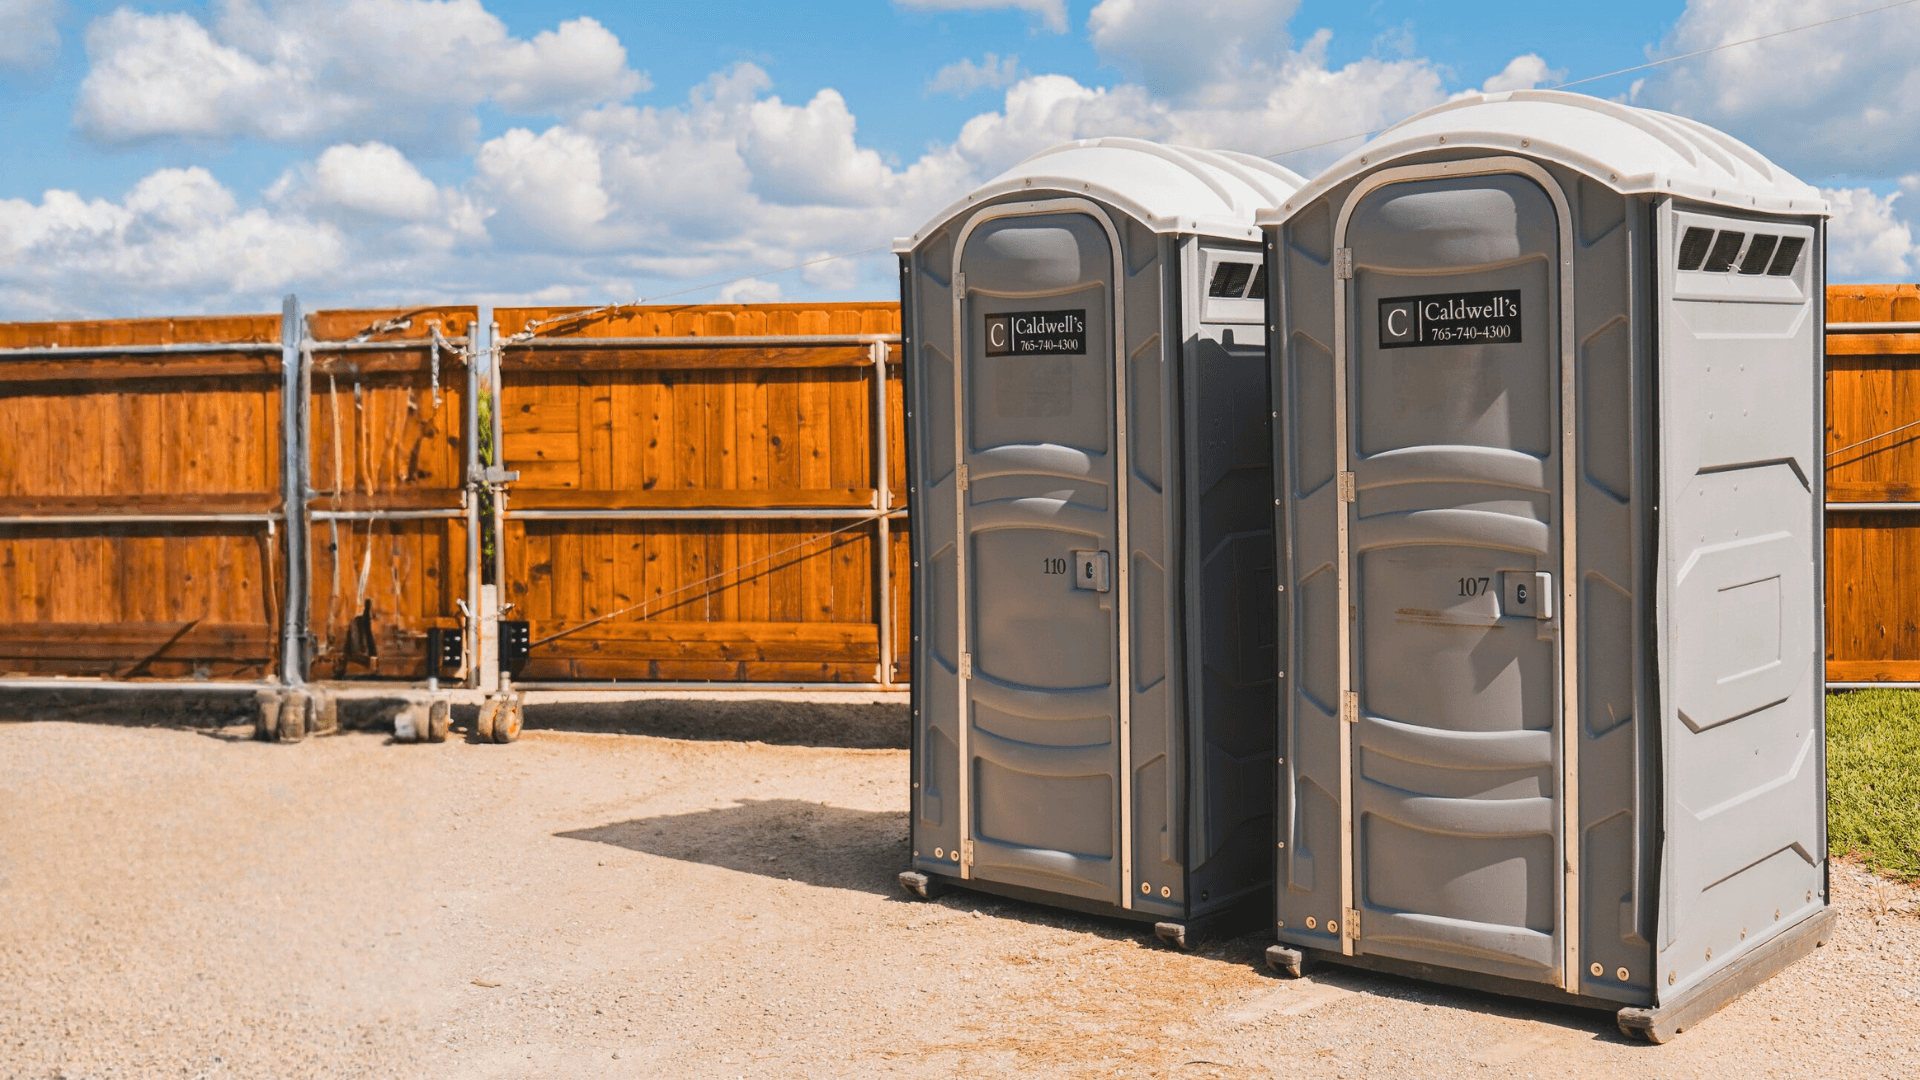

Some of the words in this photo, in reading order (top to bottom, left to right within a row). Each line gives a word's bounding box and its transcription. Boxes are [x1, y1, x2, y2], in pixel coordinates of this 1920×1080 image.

[1425, 296, 1517, 321] Caldwell's
[1015, 314, 1083, 335] Caldwell's
[1387, 308, 1408, 337] C
[1431, 324, 1511, 341] 765-740-4300
[990, 322, 1005, 347] C
[1020, 338, 1079, 351] 765-740-4300
[1043, 557, 1067, 575] 110
[1457, 577, 1490, 597] 107
